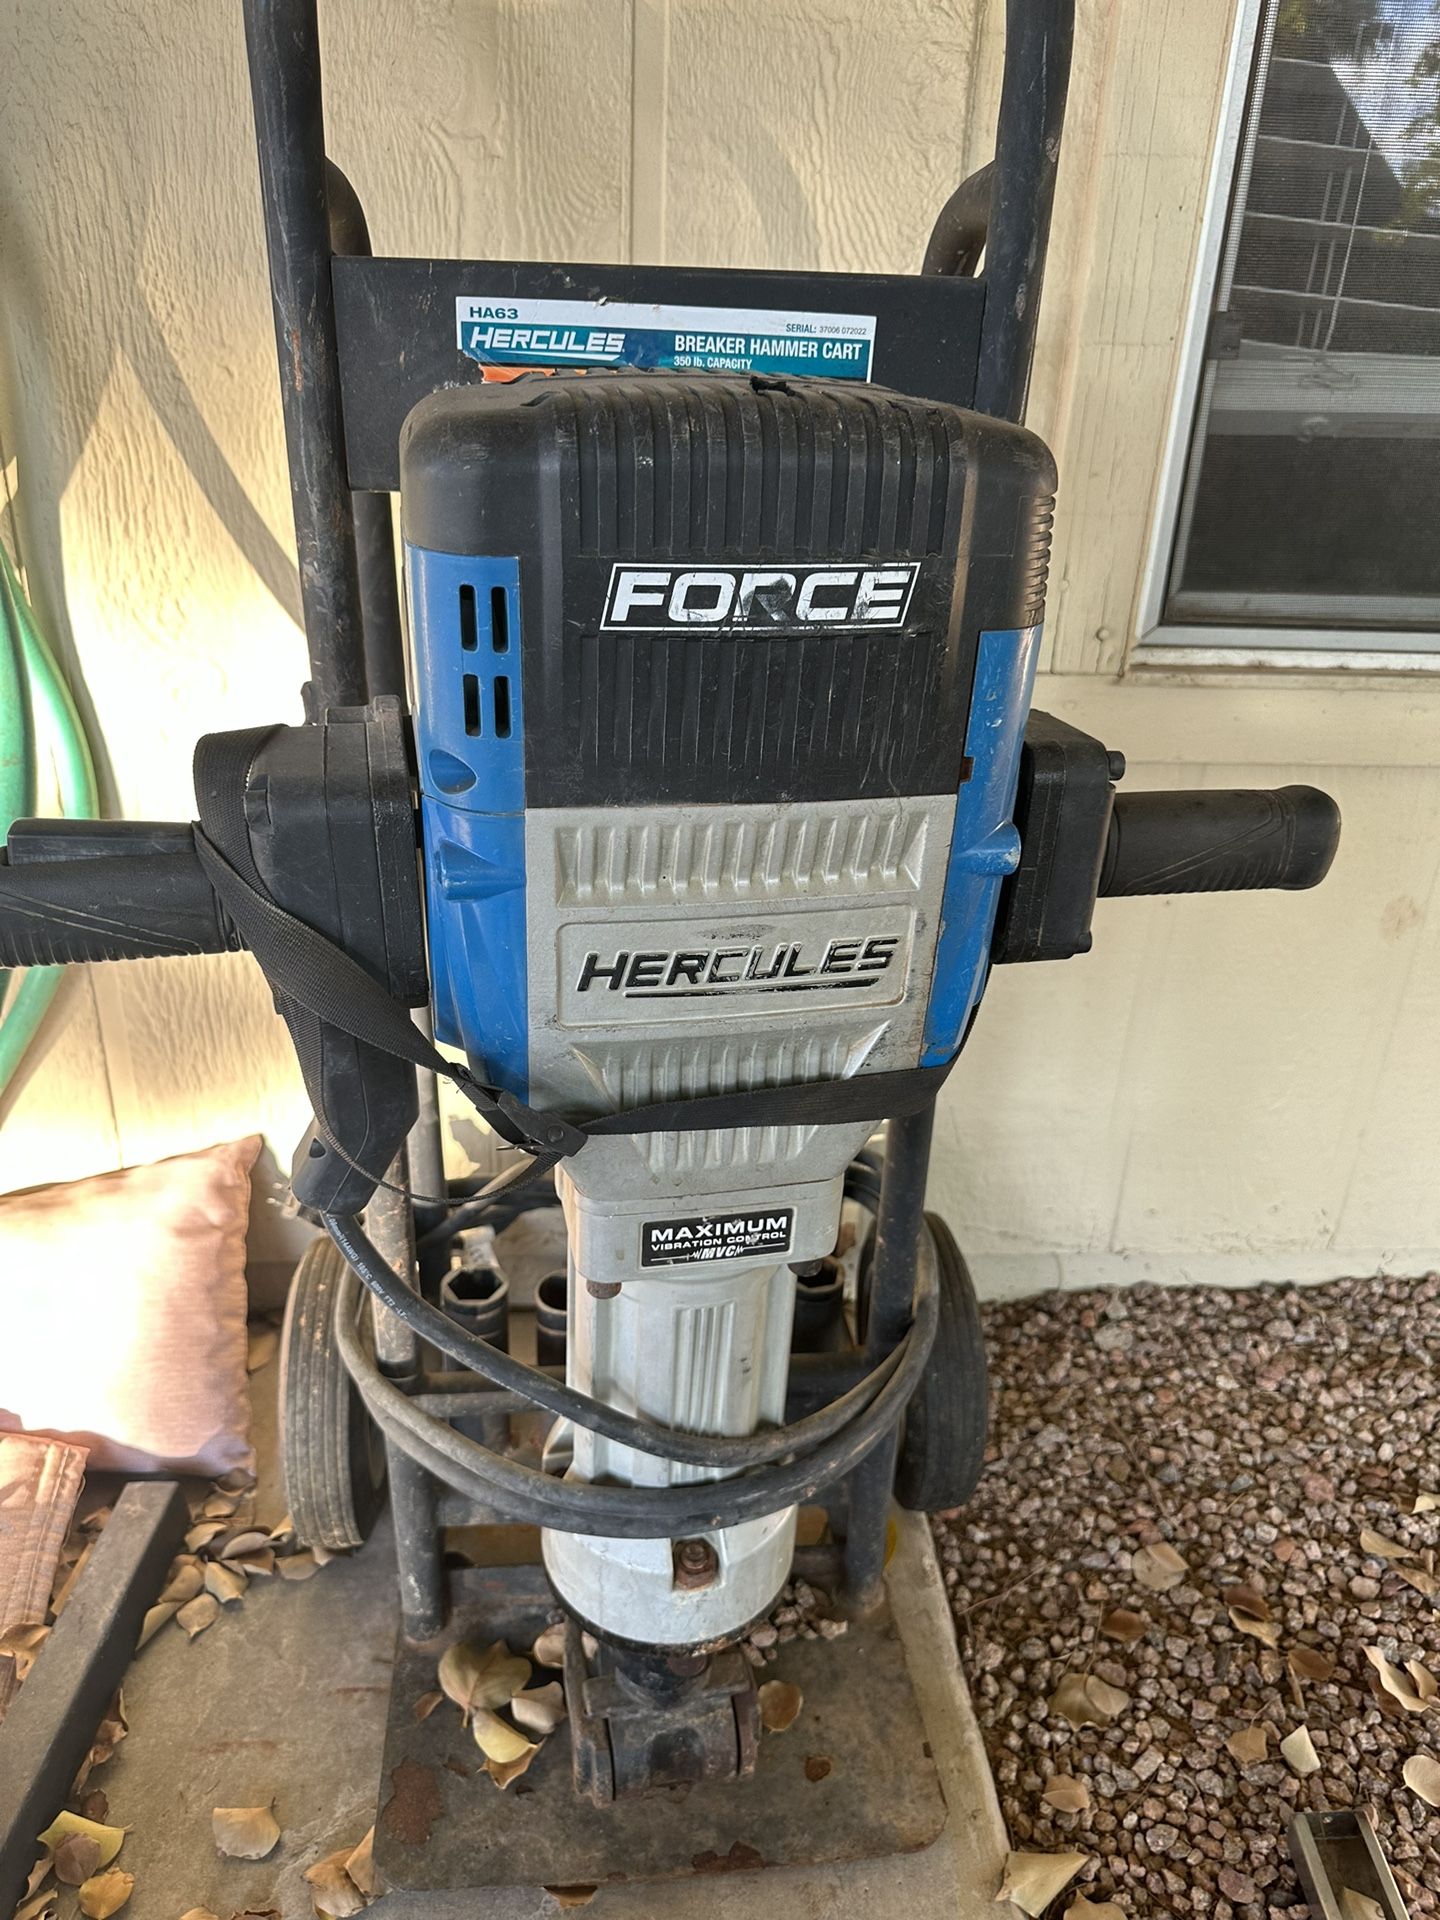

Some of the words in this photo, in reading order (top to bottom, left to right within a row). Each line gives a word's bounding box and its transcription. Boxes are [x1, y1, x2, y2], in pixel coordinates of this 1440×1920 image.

[469, 306, 519, 319] HA63
[470, 326, 626, 353] HERCULES
[785, 323, 817, 334] SERIAL:
[819, 325, 840, 335] 37006
[841, 326, 867, 336] 072022
[674, 334, 746, 355] BREAKER
[750, 338, 818, 359] HAMMER
[822, 341, 863, 361] CART
[673, 355, 692, 367] 350
[693, 356, 705, 368] lb.
[706, 357, 753, 370] CAPACITY
[610, 571, 911, 622] FORCE
[576, 936, 900, 991] HERCULES
[651, 1216, 788, 1243] MAXIMUM
[651, 1237, 722, 1251] VIBRATION
[726, 1231, 787, 1244] CONTROL
